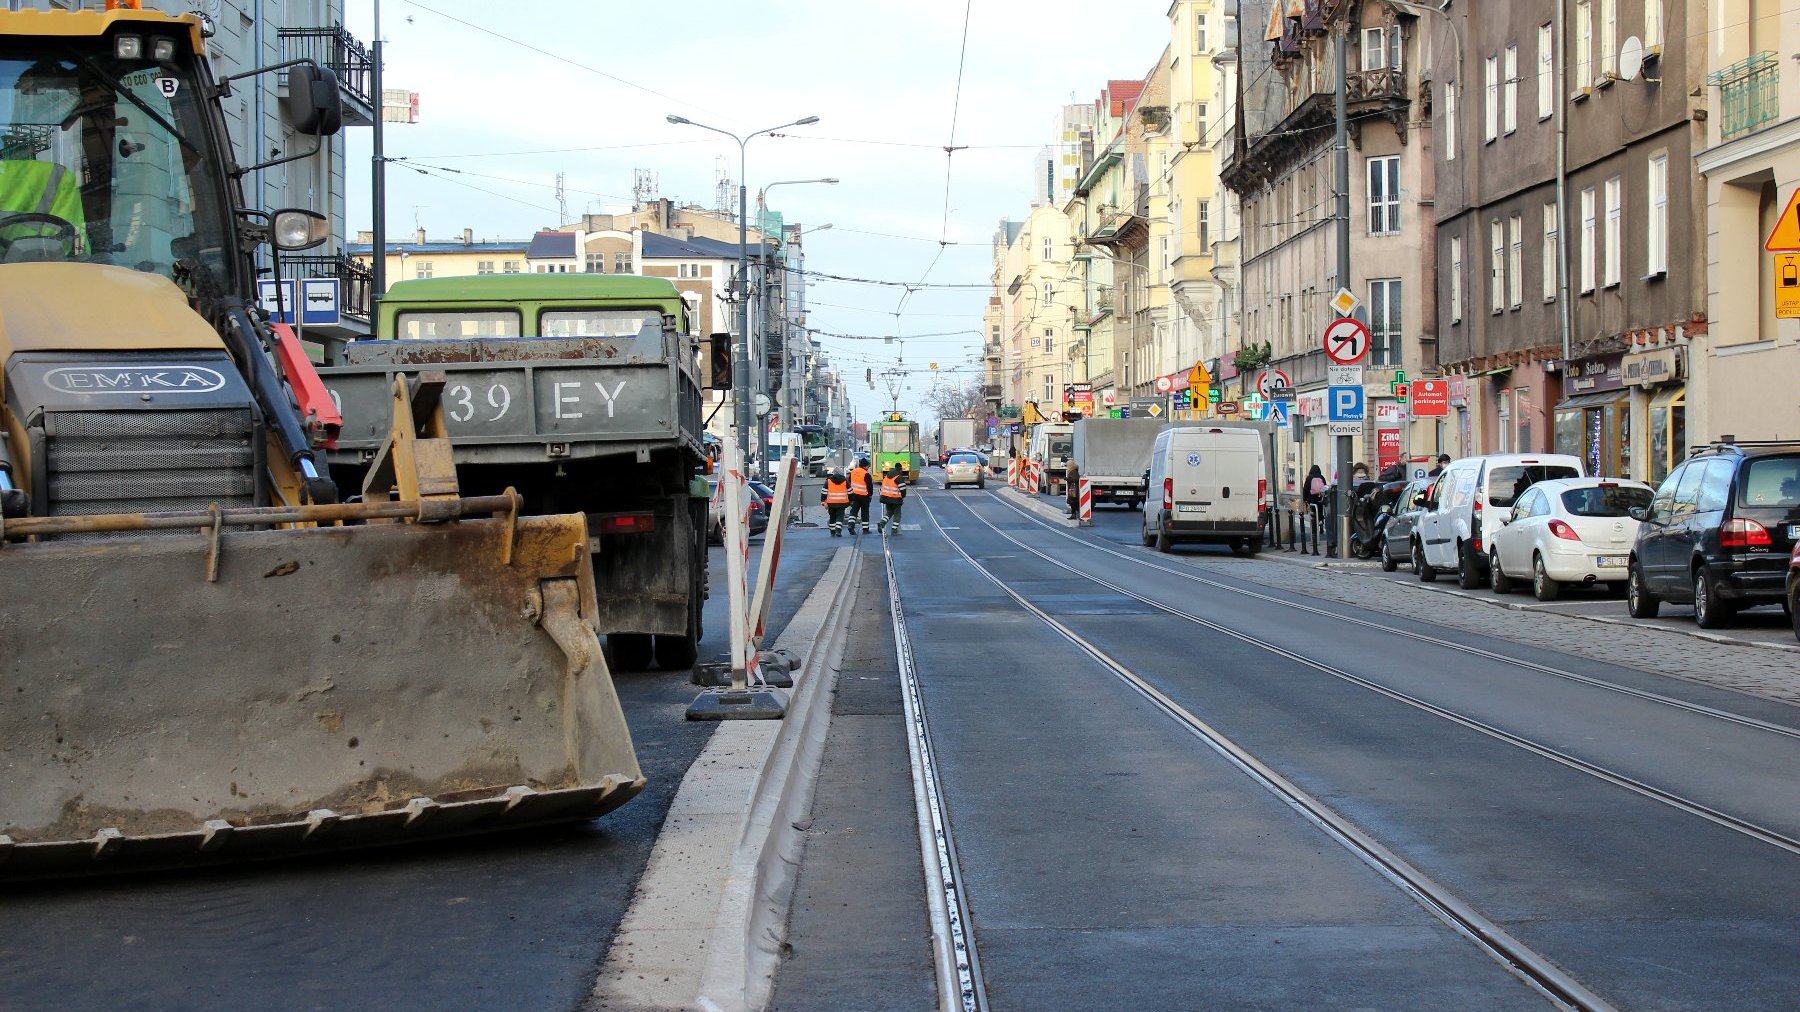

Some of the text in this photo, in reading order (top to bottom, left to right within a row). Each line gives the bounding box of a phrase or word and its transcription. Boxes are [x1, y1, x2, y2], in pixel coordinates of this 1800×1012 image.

[162, 80, 174, 93] B
[554, 381, 627, 419] EY
[1336, 389, 1357, 417] P
[1329, 424, 1361, 433] Koniec
